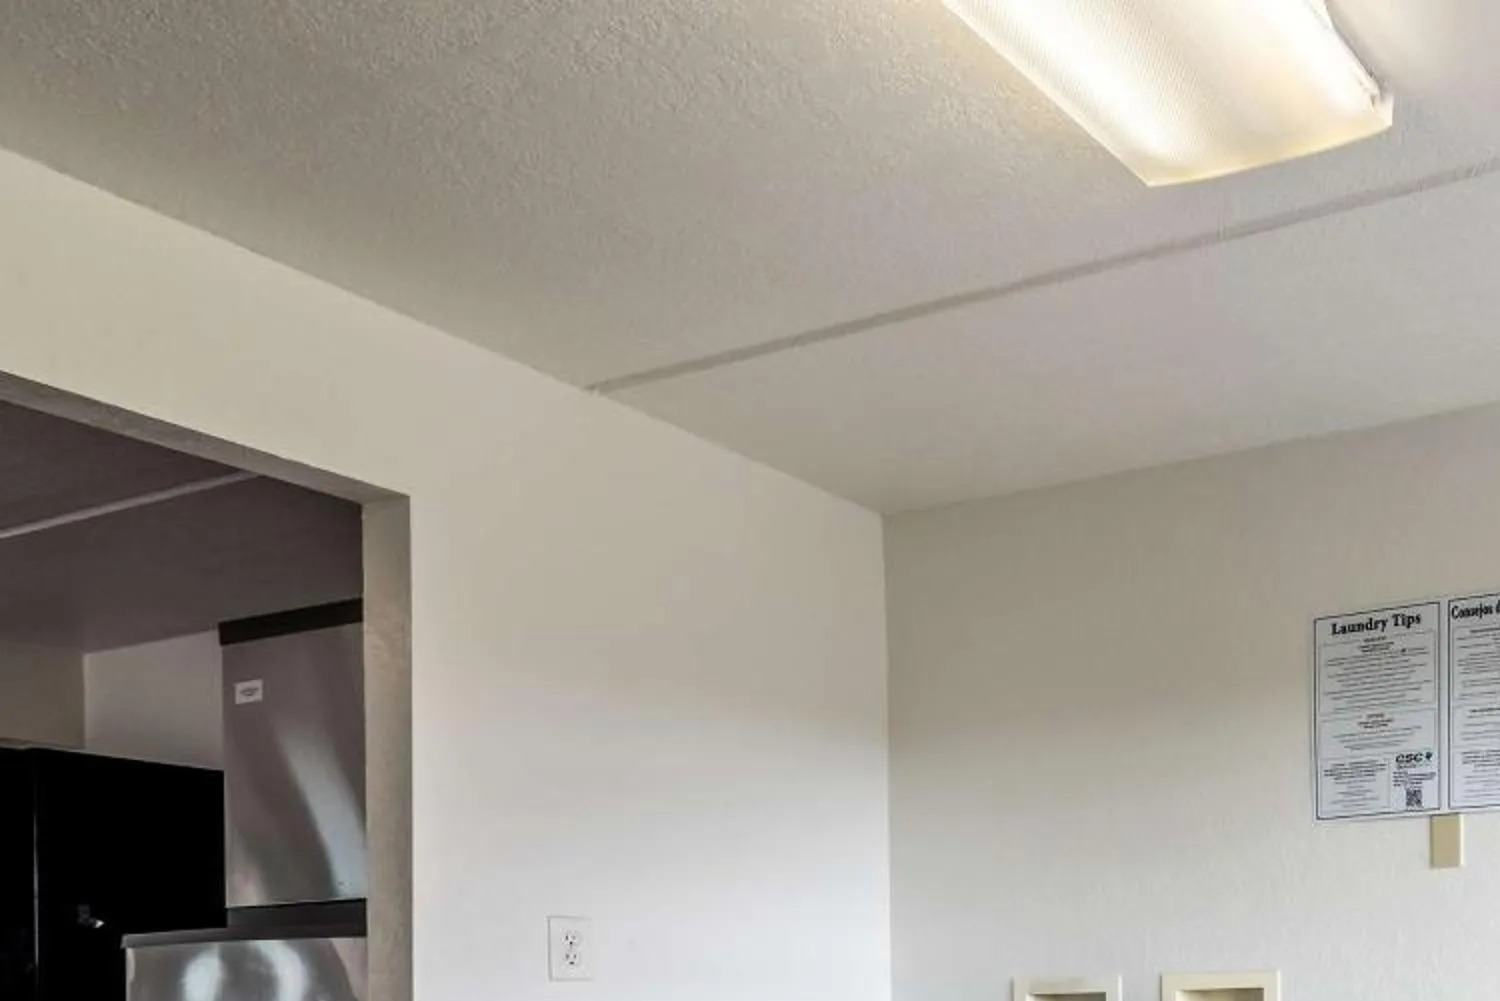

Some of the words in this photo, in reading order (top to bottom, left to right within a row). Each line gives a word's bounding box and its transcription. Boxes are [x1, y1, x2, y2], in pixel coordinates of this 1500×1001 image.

[1451, 603, 1493, 620] Consejos
[1331, 617, 1389, 636] Laundry
[1391, 612, 1422, 629] Tips
[1395, 752, 1423, 763] CSC
